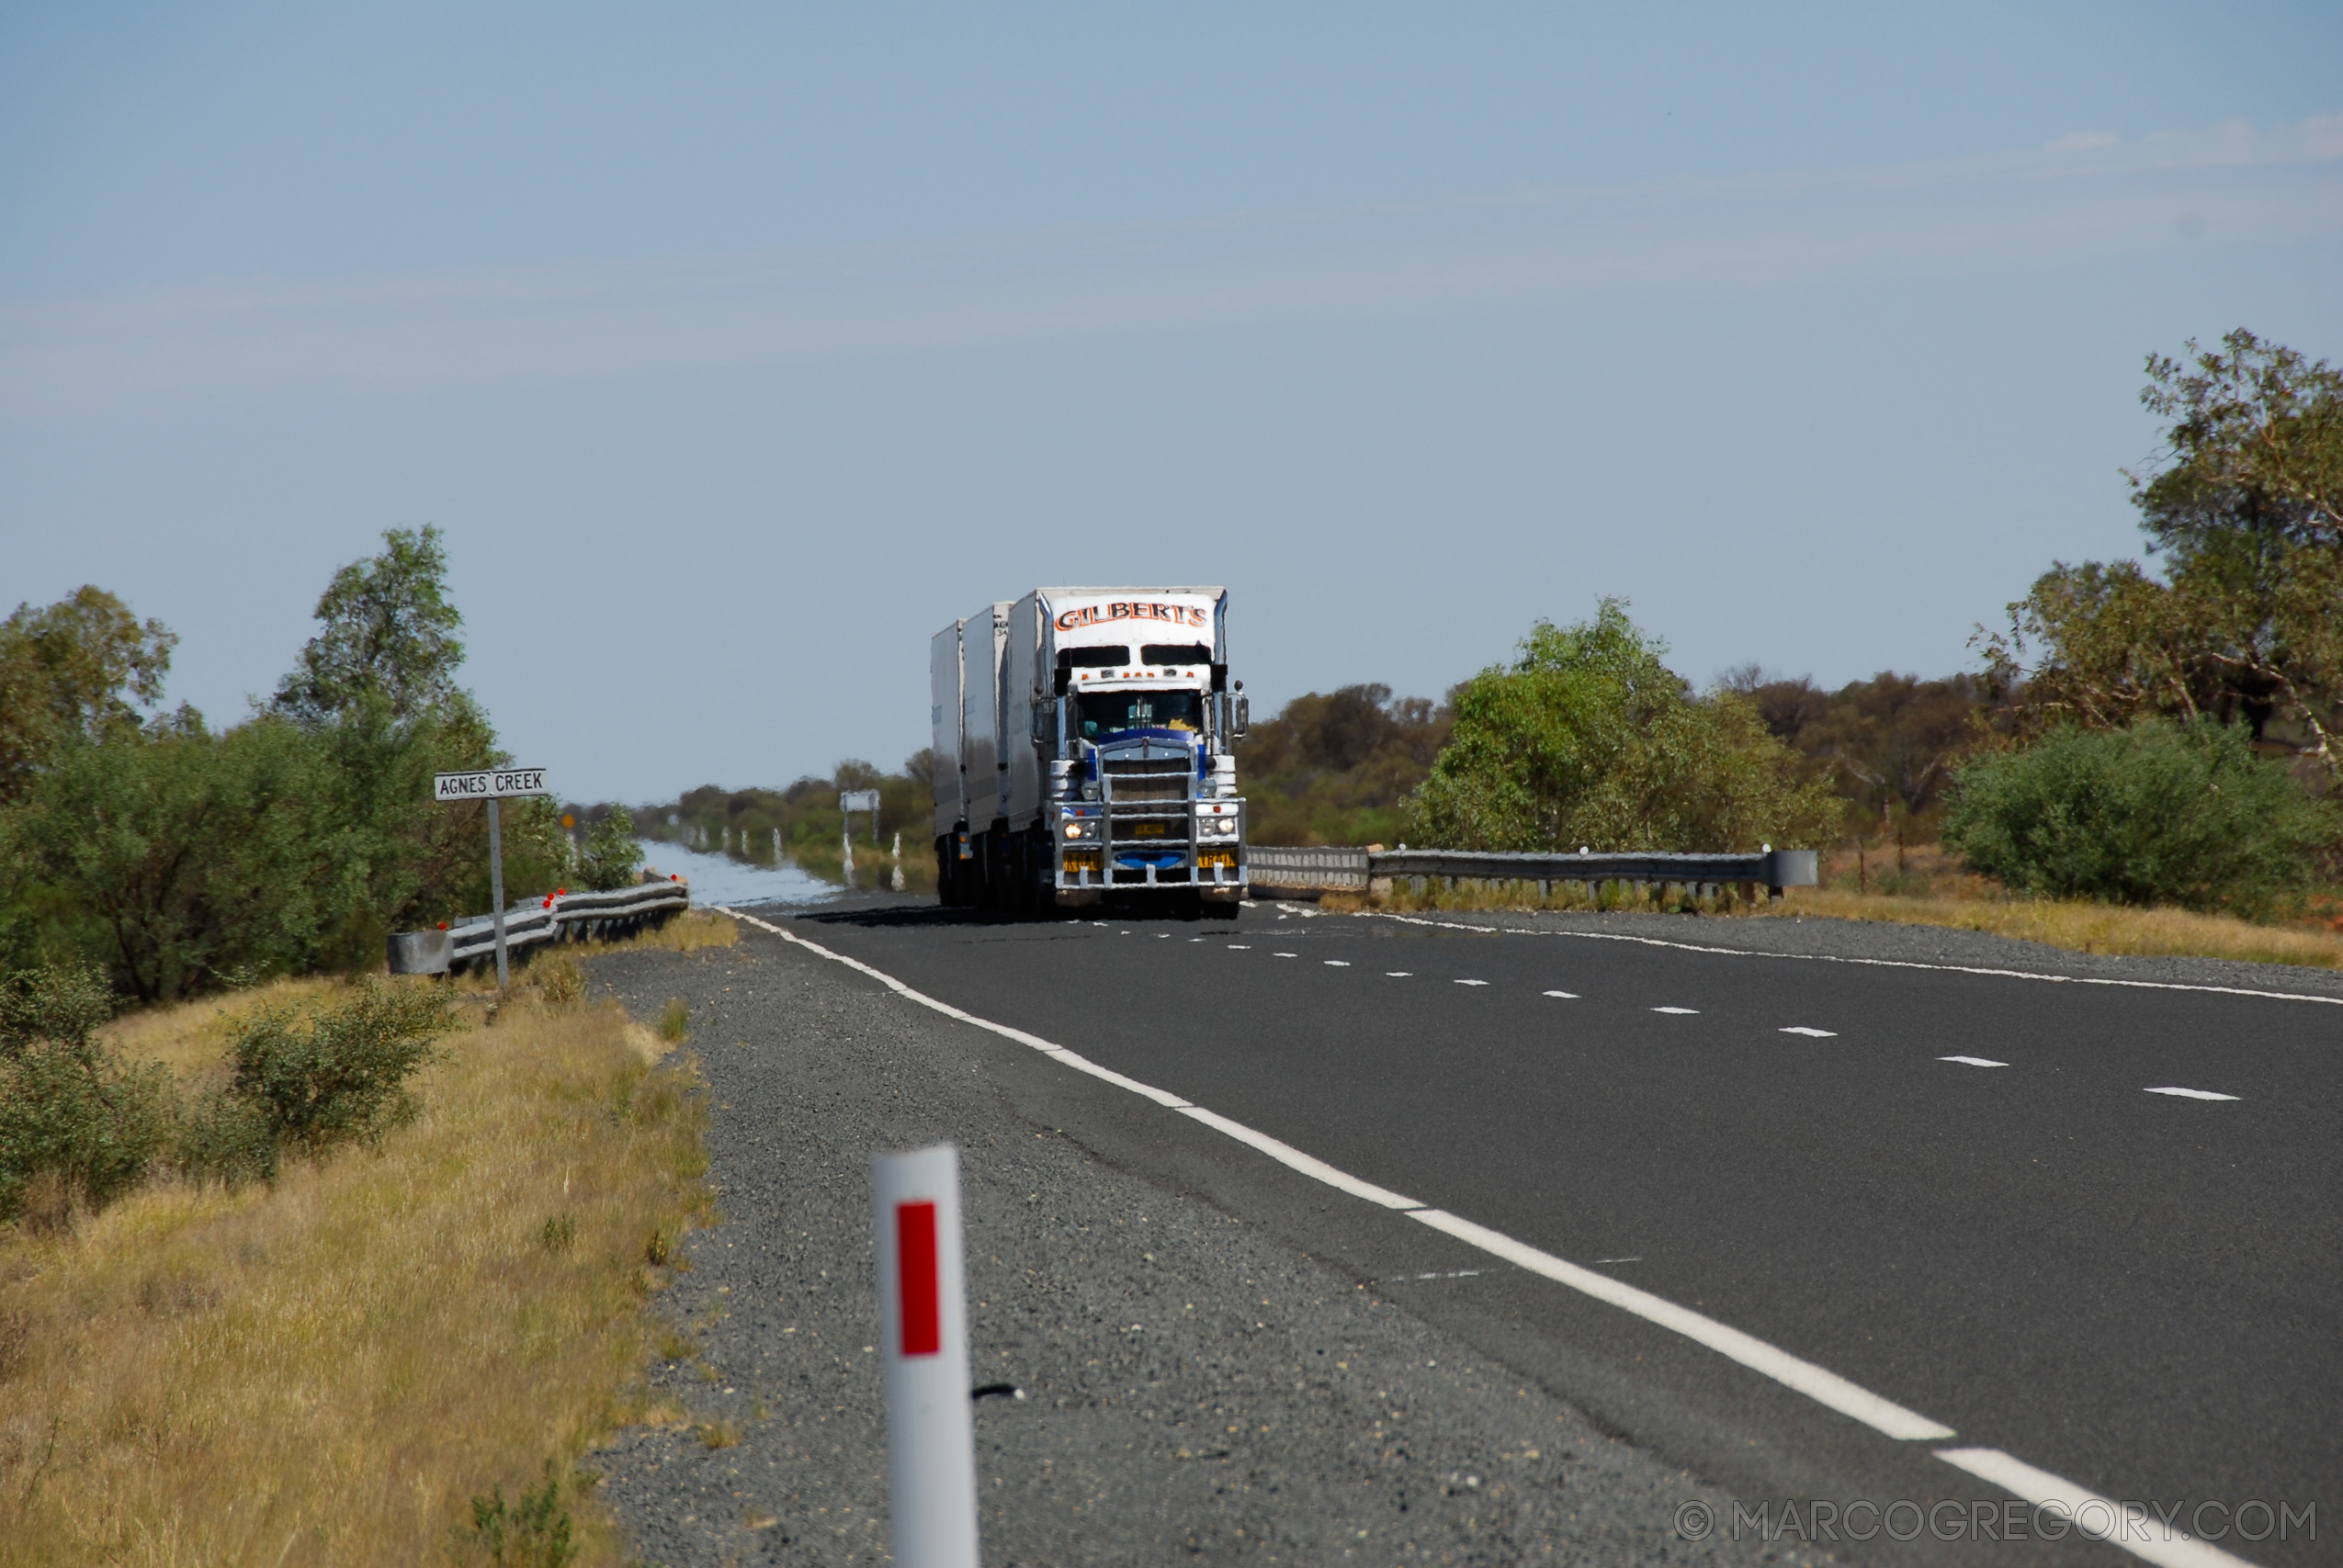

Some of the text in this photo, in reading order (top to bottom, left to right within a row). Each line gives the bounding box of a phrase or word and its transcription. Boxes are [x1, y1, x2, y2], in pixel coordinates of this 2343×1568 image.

[440, 773, 543, 795] AGNES CREEK
[1066, 852, 1101, 871] ROAD
